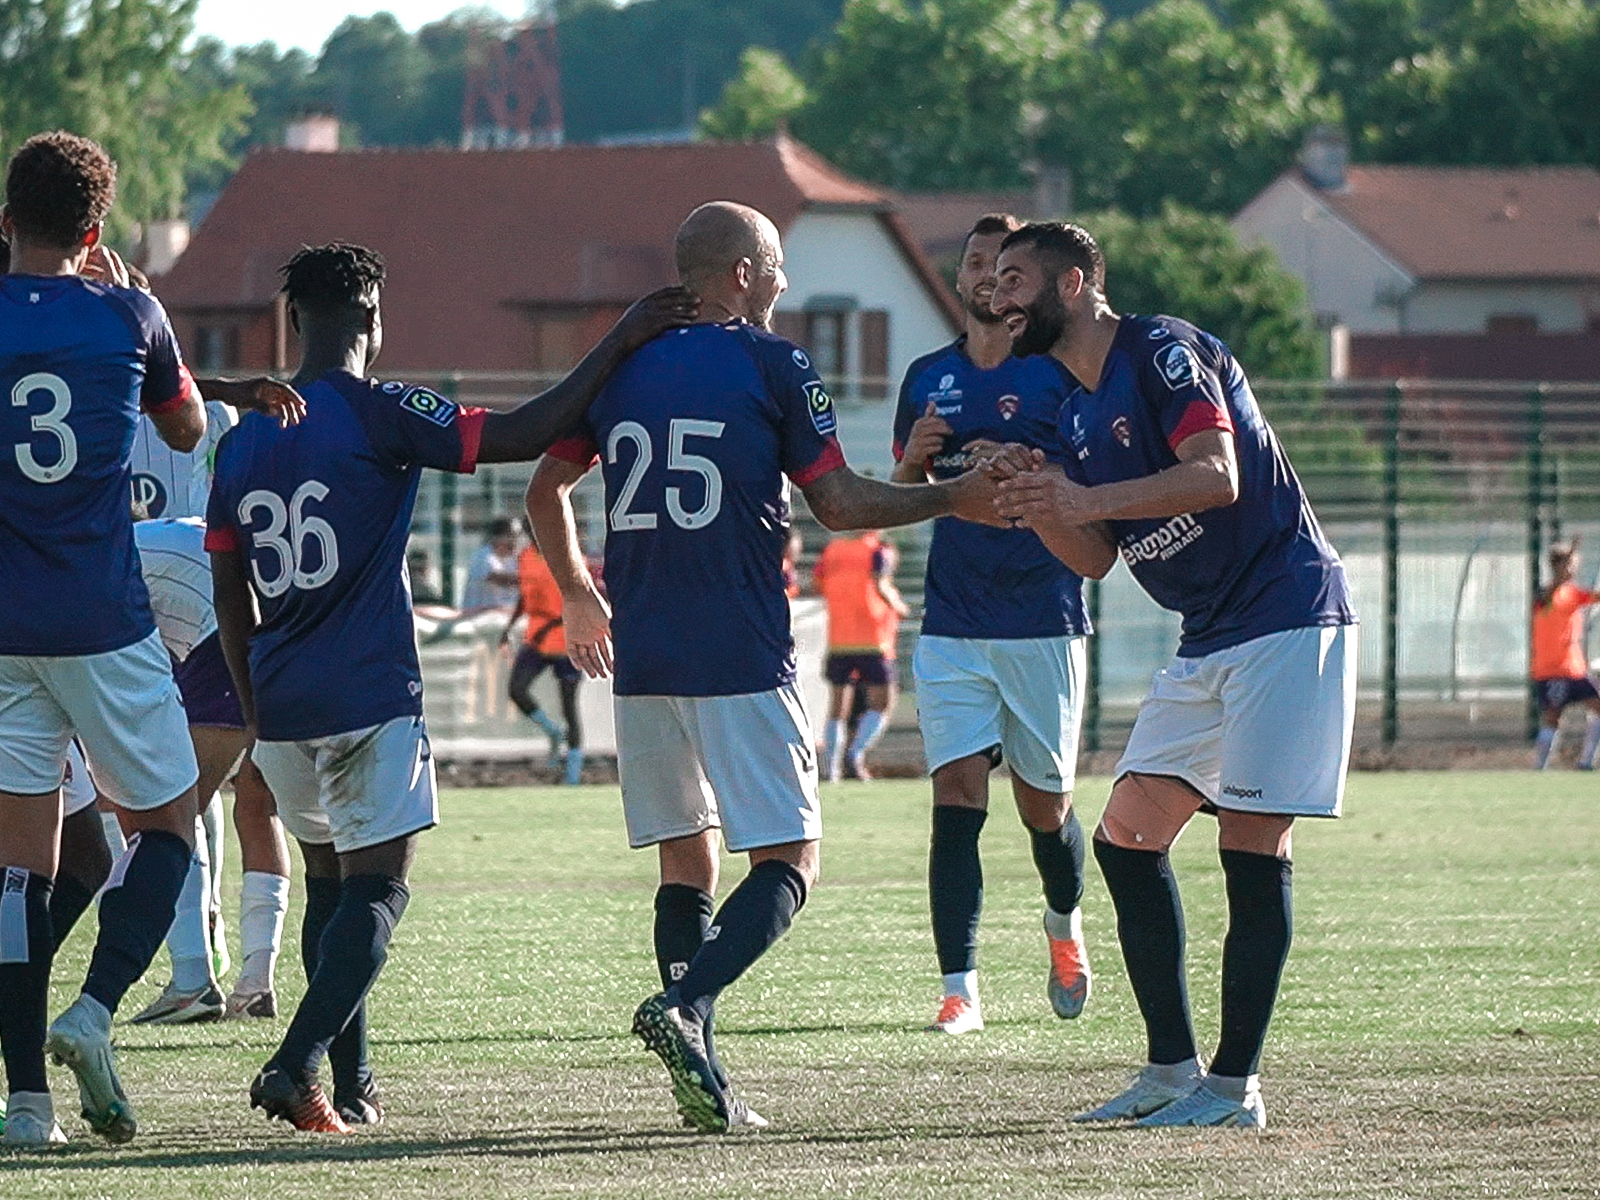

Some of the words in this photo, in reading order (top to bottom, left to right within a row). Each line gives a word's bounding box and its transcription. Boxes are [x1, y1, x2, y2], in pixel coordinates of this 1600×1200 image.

[11, 372, 77, 484] 3
[607, 419, 725, 531] 25
[238, 480, 339, 598] 36
